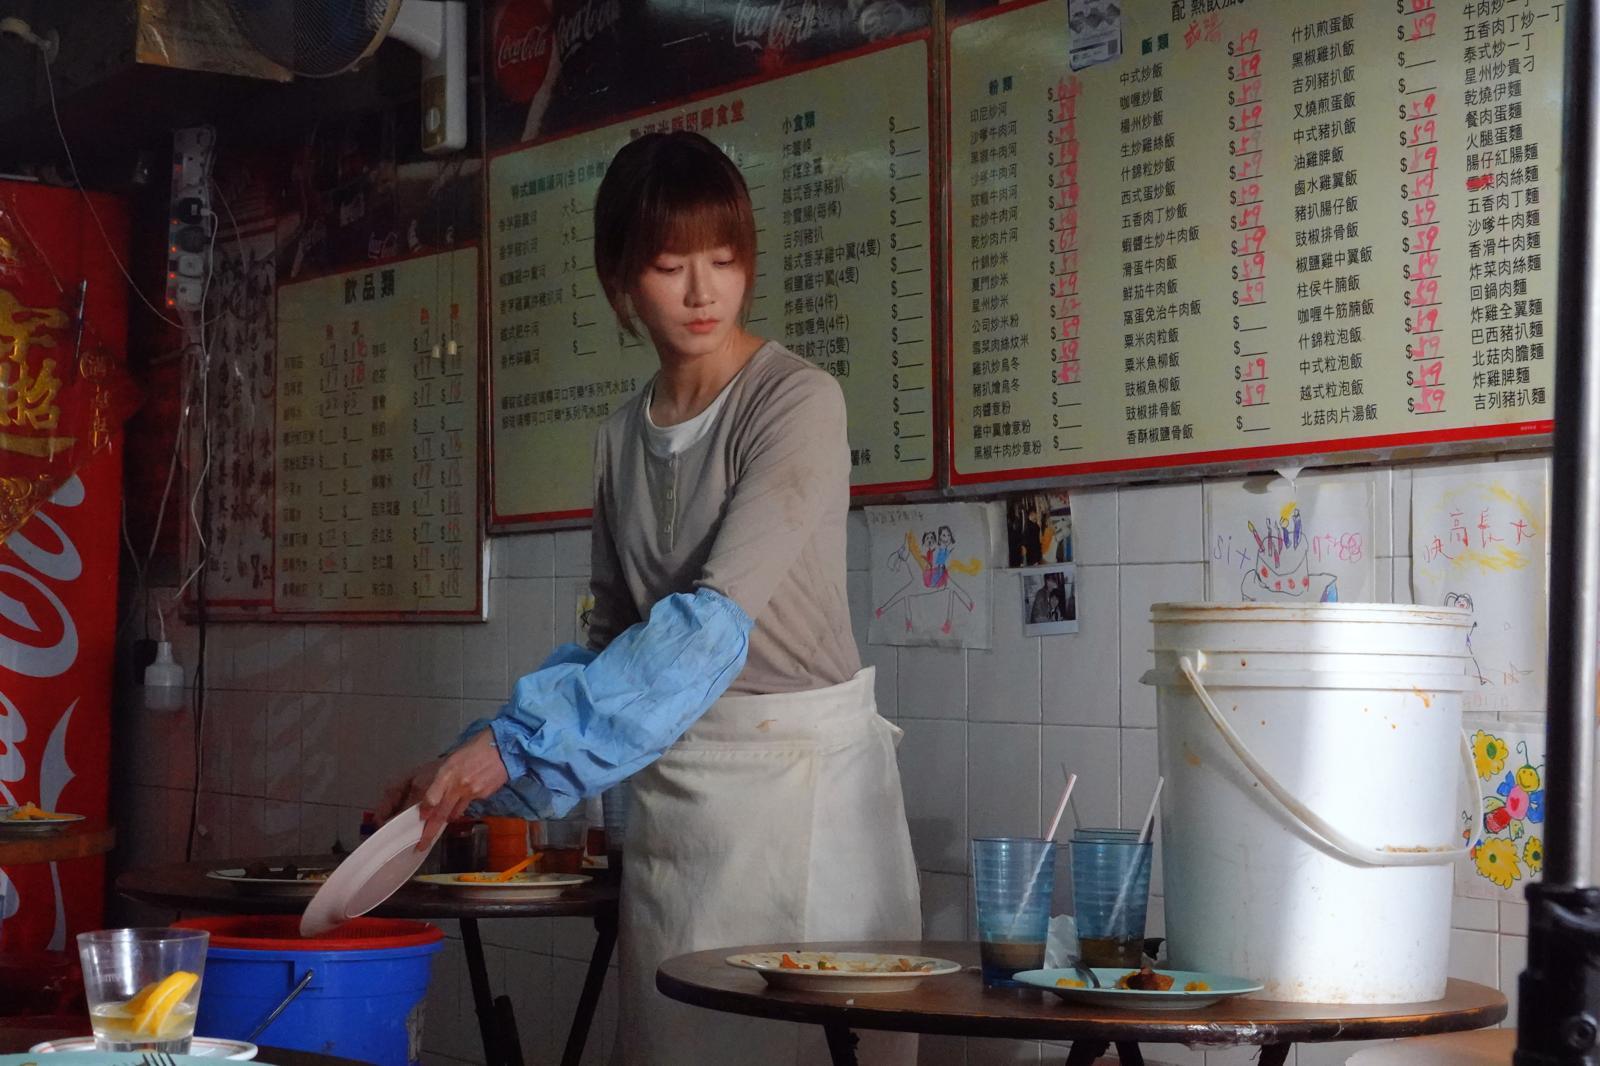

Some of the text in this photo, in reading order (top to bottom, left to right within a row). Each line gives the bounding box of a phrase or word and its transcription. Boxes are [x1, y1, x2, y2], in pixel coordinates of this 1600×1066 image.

[1292, 13, 1354, 44] 什扒煎蛋飯
[1463, 5, 1563, 41] 五香肉丁炒一丁
[1292, 40, 1355, 69] 黑椒雞扒飯
[1464, 33, 1534, 63] 泰式炒一丁
[1120, 62, 1163, 86] 中式炒飯
[1293, 65, 1355, 95] 吉列豬扒飯
[1465, 55, 1535, 85] 星州炒貴刁
[1120, 86, 1163, 110] 咖喱炒飯
[1293, 91, 1356, 120] 叉燒煎蛋飯
[1464, 80, 1522, 107] 乾燒伊麵
[1465, 101, 1522, 128] 餐肉蛋麵
[1293, 118, 1356, 145] 中式豬扒飯
[1466, 123, 1523, 151] 火腿蛋麵
[1121, 132, 1175, 158] 生炒雞絲飯
[1466, 142, 1539, 172] 腸仔紅腸麵
[1121, 156, 1175, 181] 什錦粒炒飯
[1121, 181, 1176, 205] 西式蛋炒飯
[1294, 169, 1357, 196] 鹵水雞翼飯
[1295, 195, 1358, 222] 豬扒腸仔飯
[1468, 187, 1540, 214] 五香肉丁麵
[1122, 203, 1188, 229] 五香肉丁炒飯
[1468, 209, 1540, 237] 沙嗲牛肉麵
[1295, 222, 1359, 247] 豉椒排骨飯
[1469, 231, 1541, 258] 香滑牛肉麵
[1123, 254, 1177, 278] 滑蛋牛肉飯
[1296, 246, 1372, 274] 椒鹽雞中翼飯
[1123, 279, 1178, 301] 鮮茄牛肉飯
[1297, 274, 1360, 299] 柱侯牛腩飯
[1470, 278, 1527, 301] 回鍋肉麵
[1297, 298, 1374, 324] 咖喱牛筋腩飯
[1471, 298, 1543, 324] 炸雞全翼麵
[1298, 327, 1362, 350] 什錦粒泡飯
[1472, 320, 1544, 345] 巴西豬扒麵
[1299, 353, 1363, 376] 中式粒泡飯
[1125, 376, 1181, 397] 豉椒魚柳飯
[1300, 379, 1363, 402] 越式粒泡飯
[1474, 387, 1546, 411] 吉列豬扒麵
[1126, 400, 1182, 421] 豉椒排骨飯
[1301, 404, 1378, 427] 北菇肉片湯飯
